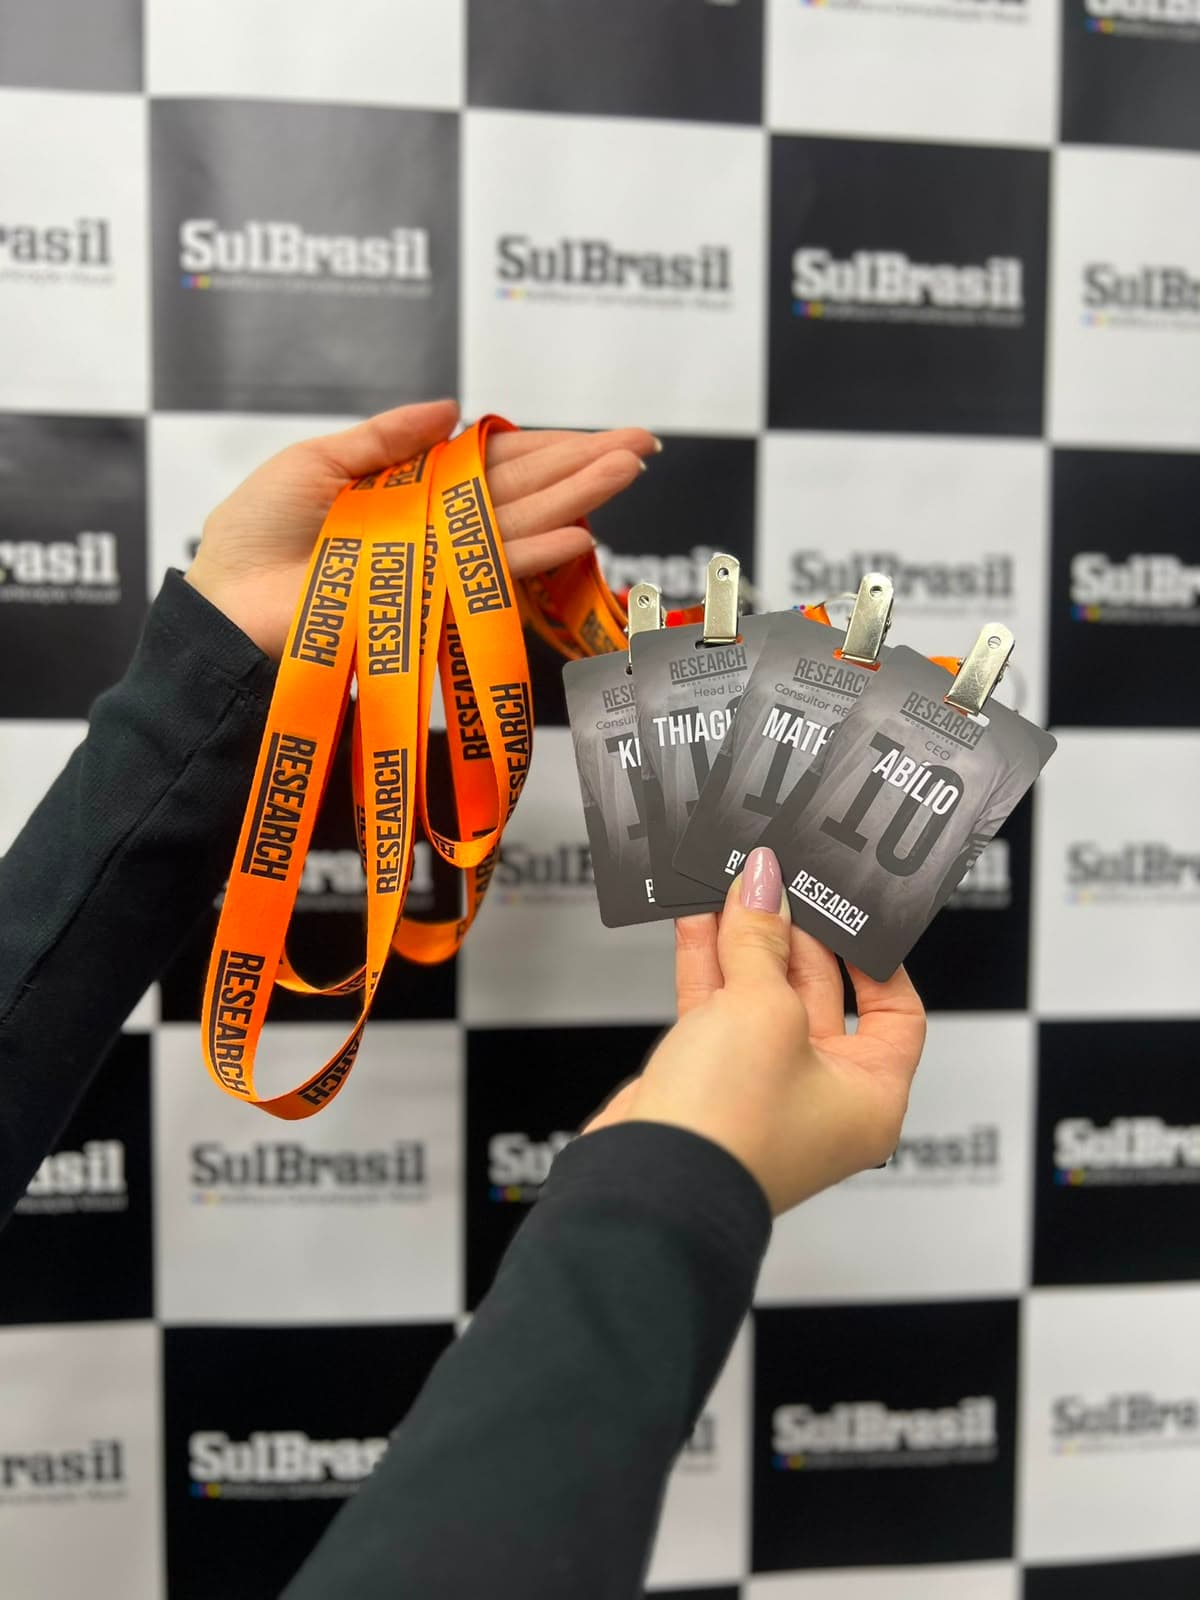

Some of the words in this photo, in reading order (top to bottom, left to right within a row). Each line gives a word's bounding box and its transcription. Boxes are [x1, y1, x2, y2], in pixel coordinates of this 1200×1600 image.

[181, 218, 431, 279] SulBrasil
[496, 234, 731, 292] SulBrasil
[793, 248, 1022, 308] SulBrasil
[442, 480, 503, 615] RESEARCH
[300, 537, 362, 668] RESEARCH
[368, 542, 405, 675] RESEARCH
[669, 647, 747, 681] RESEARCH
[694, 685, 725, 698] Head
[774, 683, 831, 711] Consultor
[903, 691, 985, 746] RESEARCH
[924, 740, 951, 761] CEO
[251, 734, 317, 881] RESEARCH
[872, 748, 959, 815] ABÍLIO
[374, 749, 401, 894] RESEARCH
[791, 870, 870, 933] RESEARCH
[215, 951, 265, 1095] RESEARCH
[191, 1141, 424, 1188] SulBrasil
[773, 1396, 997, 1454] SulBrasil
